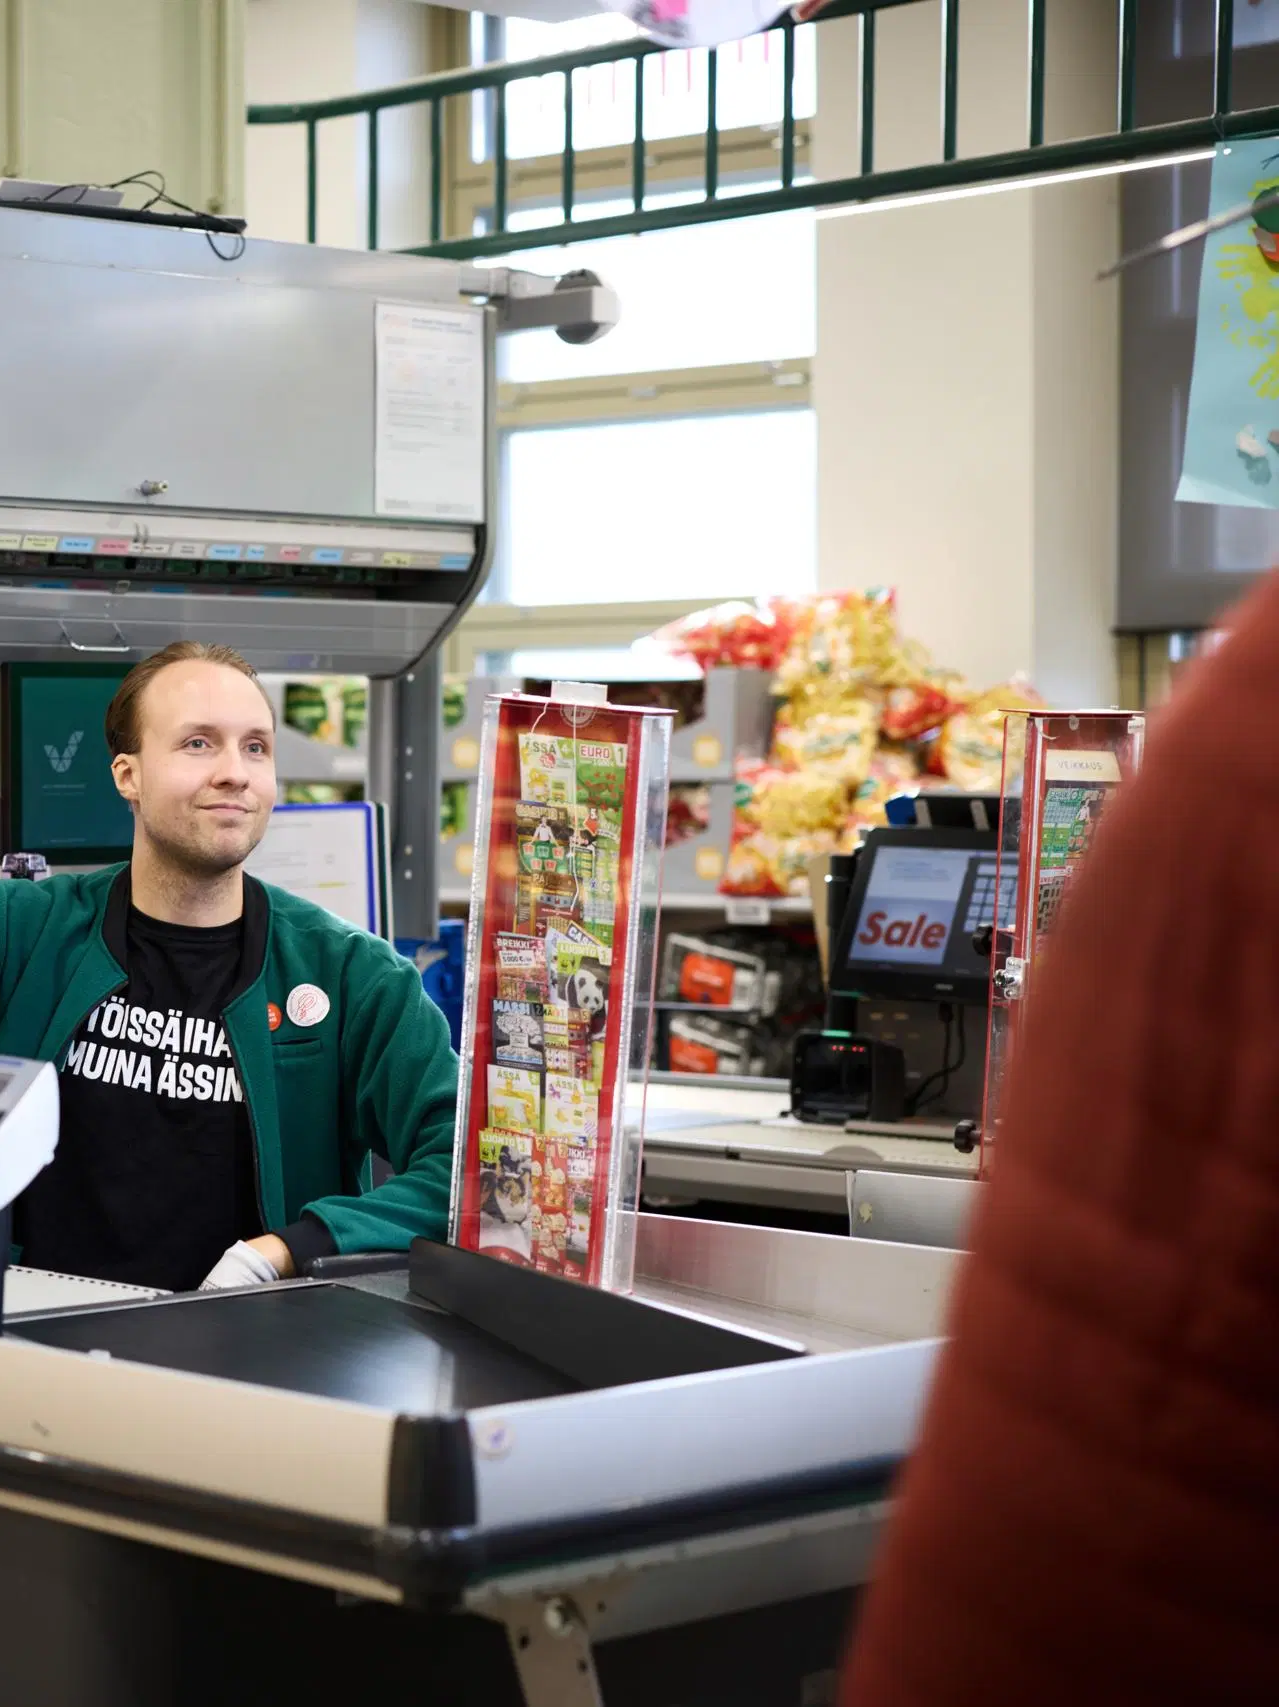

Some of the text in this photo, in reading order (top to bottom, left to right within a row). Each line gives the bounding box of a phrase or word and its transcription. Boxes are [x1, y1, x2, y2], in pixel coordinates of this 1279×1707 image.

[579, 744, 610, 759] EURO
[858, 911, 947, 949] Sale
[86, 995, 182, 1052] TÖISSÄ
[61, 1040, 152, 1093] MUINA
